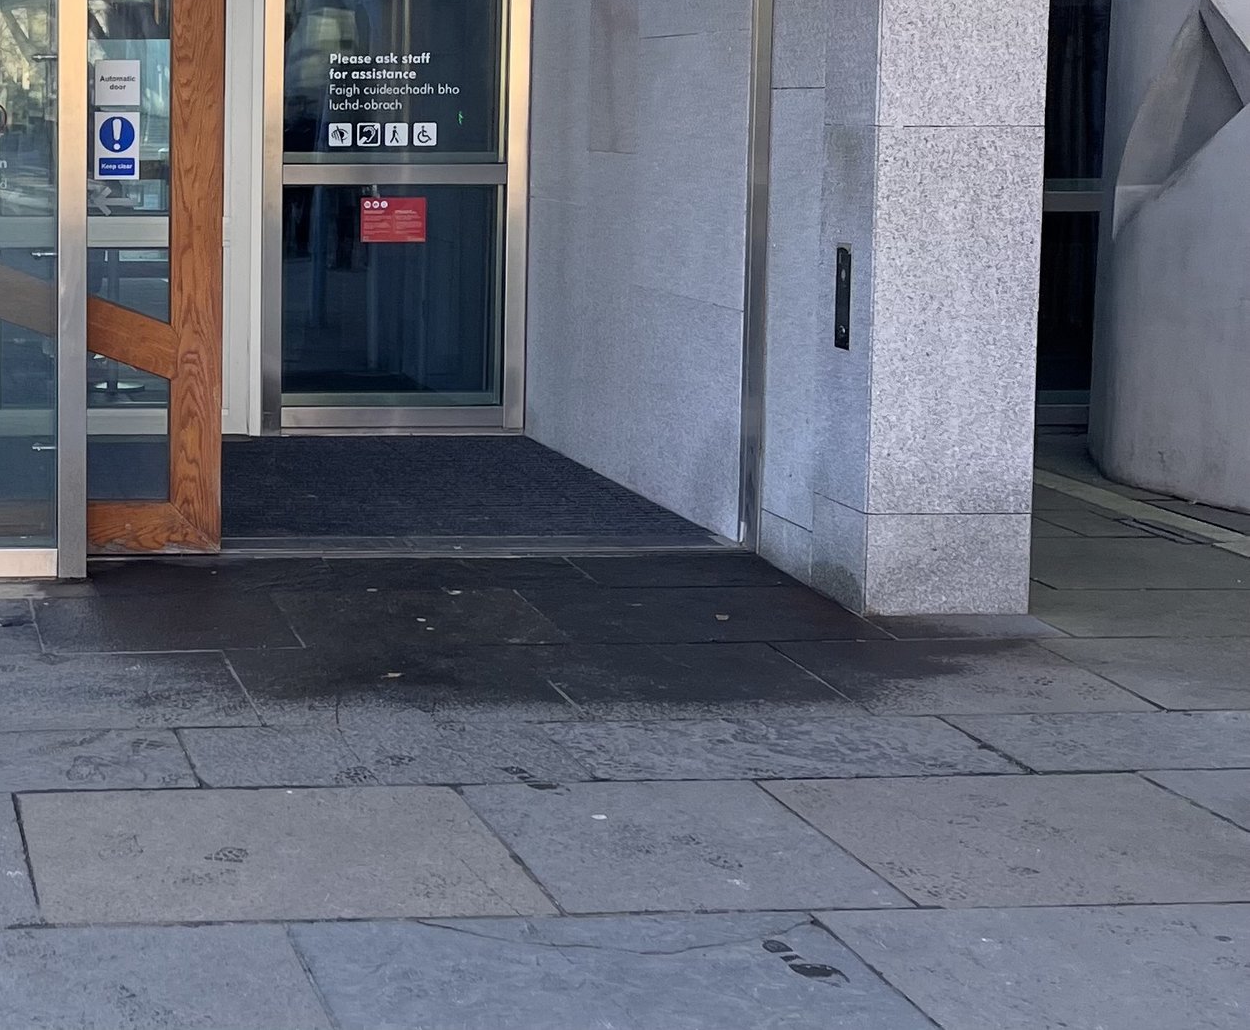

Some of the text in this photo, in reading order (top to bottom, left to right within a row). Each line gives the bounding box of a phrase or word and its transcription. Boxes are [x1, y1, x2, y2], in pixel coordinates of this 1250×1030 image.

[329, 52, 431, 65] Please ask staff
[329, 68, 417, 80] for assistance
[329, 84, 460, 97] Faigh cuideachadh bho
[329, 99, 403, 111] luchd-obrach
